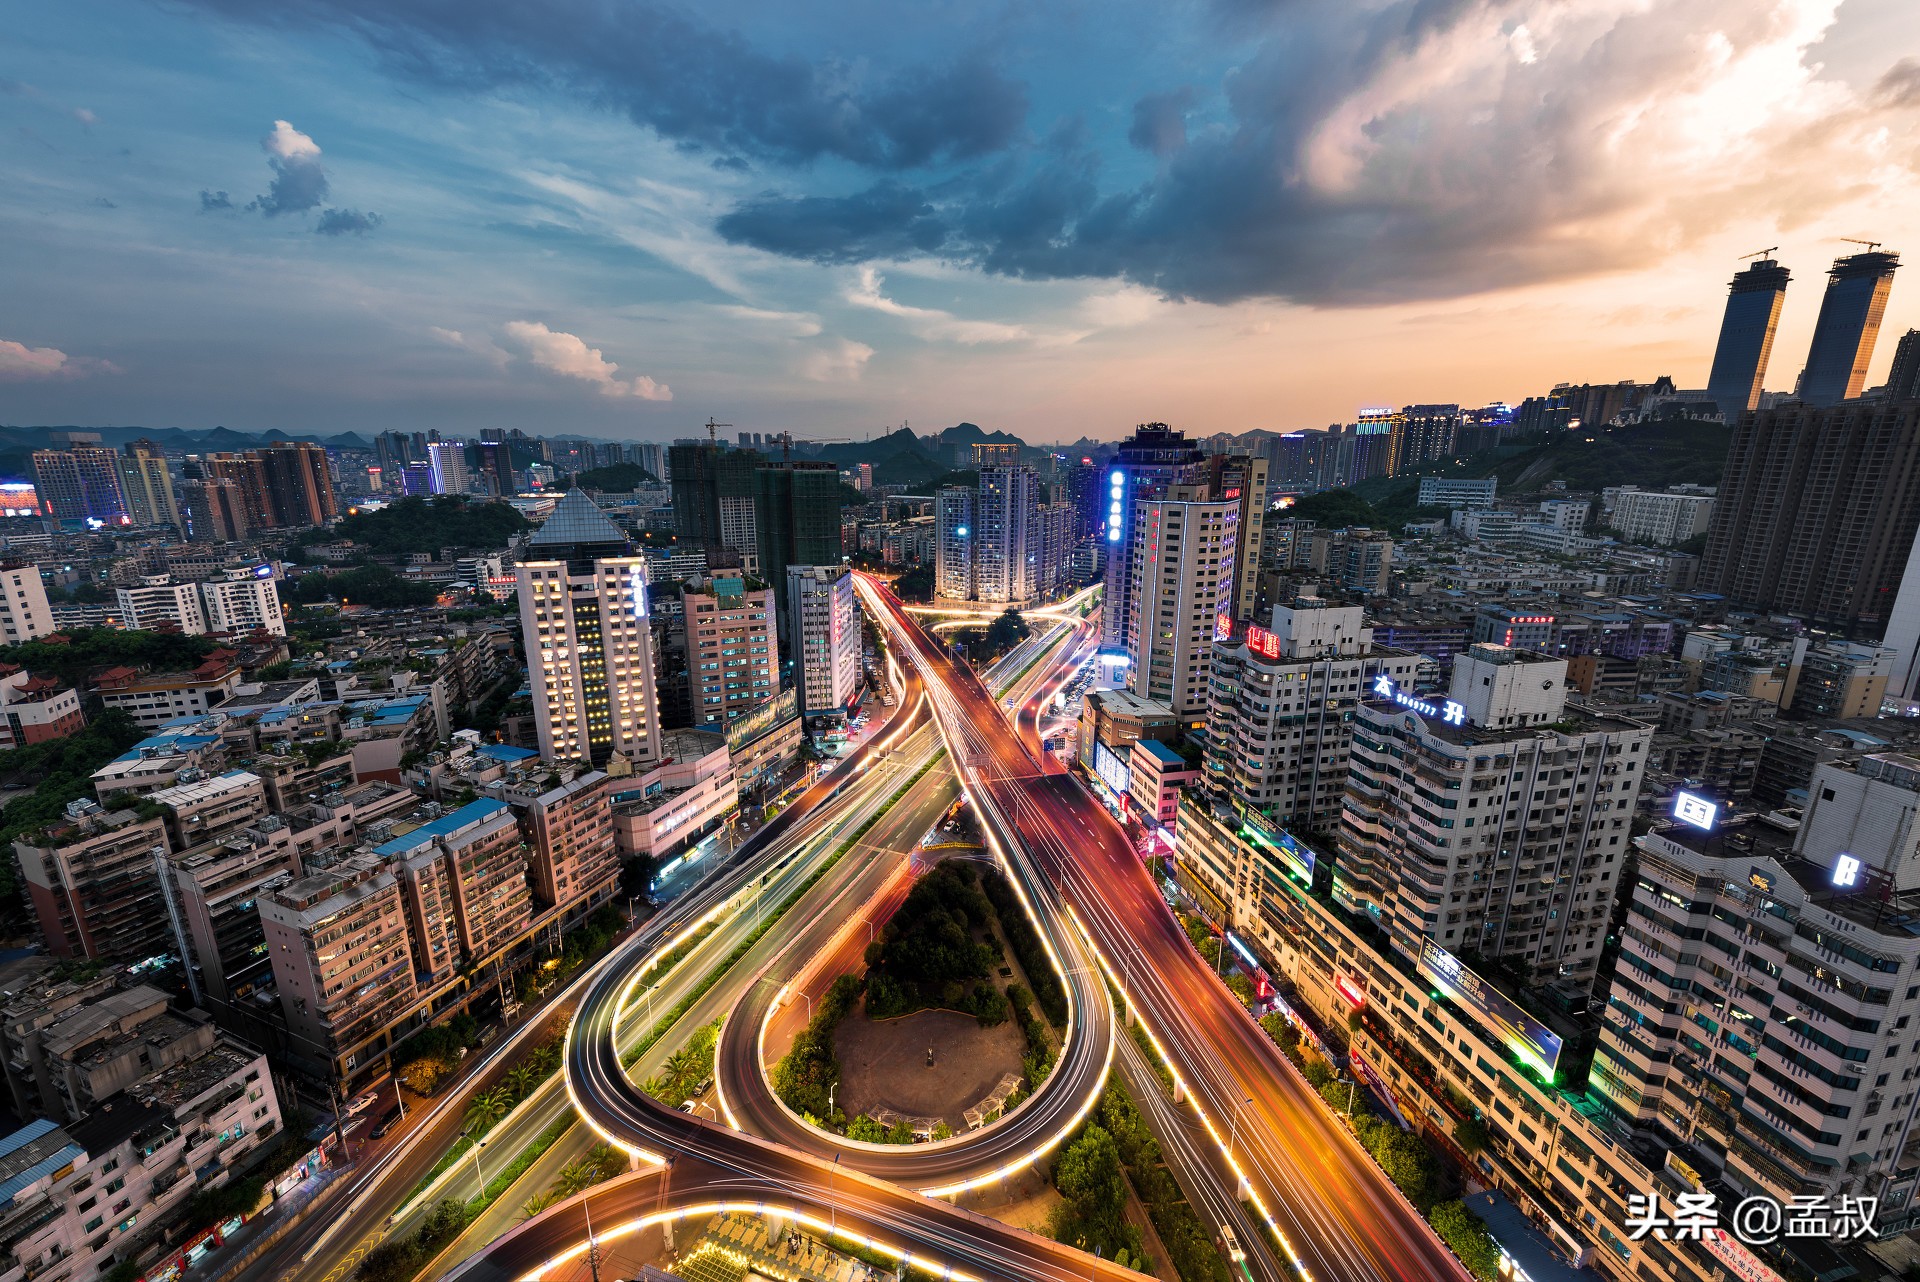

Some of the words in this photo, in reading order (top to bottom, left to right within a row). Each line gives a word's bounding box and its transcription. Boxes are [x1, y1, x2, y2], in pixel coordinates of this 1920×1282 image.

[1374, 675, 1394, 696] 太
[1396, 693, 1437, 716] 5949777
[1442, 700, 1465, 726] 升
